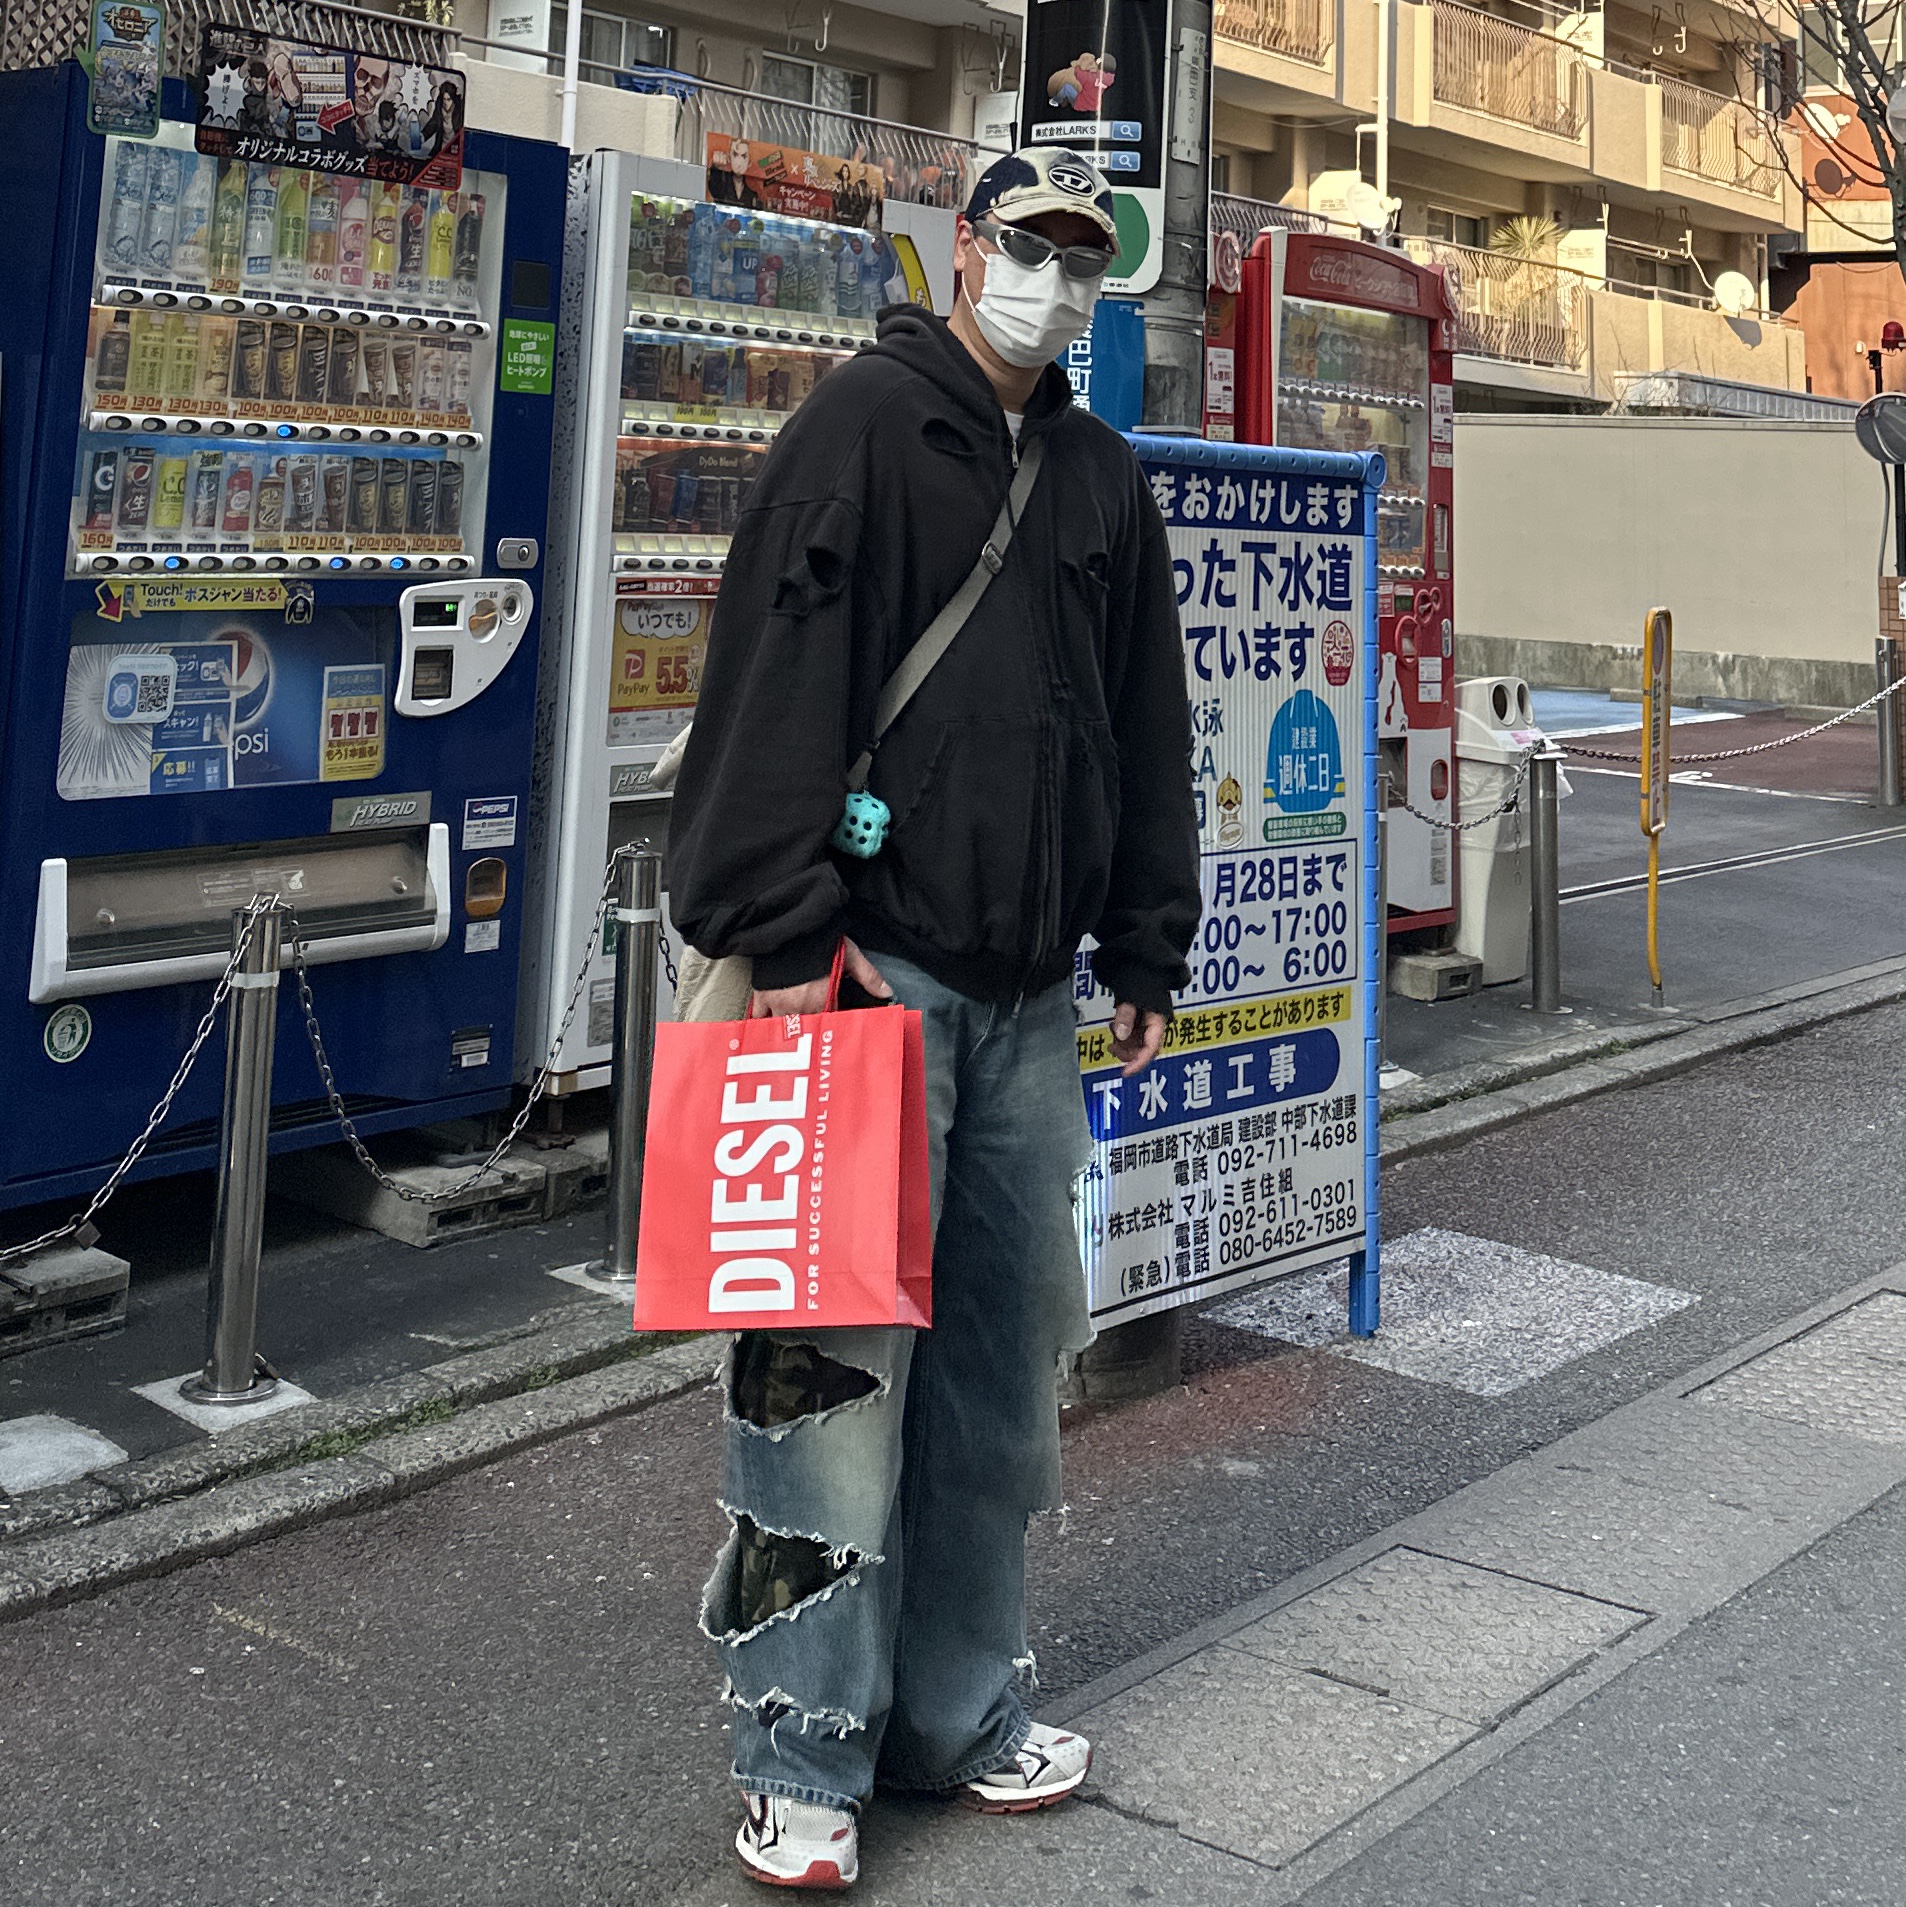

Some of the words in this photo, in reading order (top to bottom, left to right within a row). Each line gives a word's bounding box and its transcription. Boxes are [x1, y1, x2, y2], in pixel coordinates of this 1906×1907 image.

[1035, 125, 1097, 138] 株式会社LARKS
[779, 186, 816, 201] キャンペーン
[506, 365, 547, 378] ヒートポンプ
[97, 394, 128, 406] 150円
[133, 396, 163, 408] 130円
[169, 398, 198, 410] 130円
[199, 400, 228, 412] 130円
[239, 401, 267, 414] 100円
[271, 403, 298, 416] 100円
[302, 405, 328, 417] 100円
[333, 407, 359, 419] 100円
[363, 409, 388, 421] 110円
[391, 411, 415, 423] 110円
[421, 412, 445, 424] 140円
[447, 414, 471, 426] 140円
[699, 456, 718, 467] DyDo
[719, 456, 738, 467] Blend
[1151, 469, 1359, 530] をおかけします
[82, 533, 113, 545] 160円
[289, 536, 316, 547] 110円
[318, 537, 344, 547] 110円
[355, 537, 380, 547] 100円
[381, 537, 407, 548] 100円
[412, 537, 436, 548] 100円
[438, 538, 463, 548] 100円
[1172, 537, 1353, 612] った下水道
[141, 583, 183, 597] Touch!
[184, 587, 282, 603] ボスジャン当たる!
[638, 611, 692, 629] いつでも!
[1185, 621, 1315, 683] ています
[617, 682, 650, 697] PayPay
[1278, 753, 1330, 795] 週休二日
[351, 801, 417, 827] HYBRID
[480, 803, 510, 815] PEPSI
[1213, 852, 1348, 910] 月28日まで
[1163, 991, 1345, 1049] が発生することがあります
[818, 1030, 834, 1103] LIVING
[1092, 1043, 1297, 1131] 下水道工事
[1108, 1121, 1234, 1177] 福岡市道路下水道局
[1238, 1111, 1278, 1144] 建設部
[1281, 1093, 1357, 1134] 中部下水道課
[1173, 1154, 1209, 1188] 電話
[1217, 1119, 1358, 1176] 092-711-4698
[708, 1033, 813, 1313] DIESEL
[808, 1109, 829, 1256] SUCCESSFUL
[1108, 1195, 1174, 1242] 株式会社
[1180, 1166, 1294, 1218] マルミ吉住組
[1174, 1215, 1210, 1251] 電話
[1218, 1178, 1356, 1238] 092-611-0301
[1219, 1204, 1357, 1266] 080-6452-7589
[807, 1264, 820, 1311] FOR
